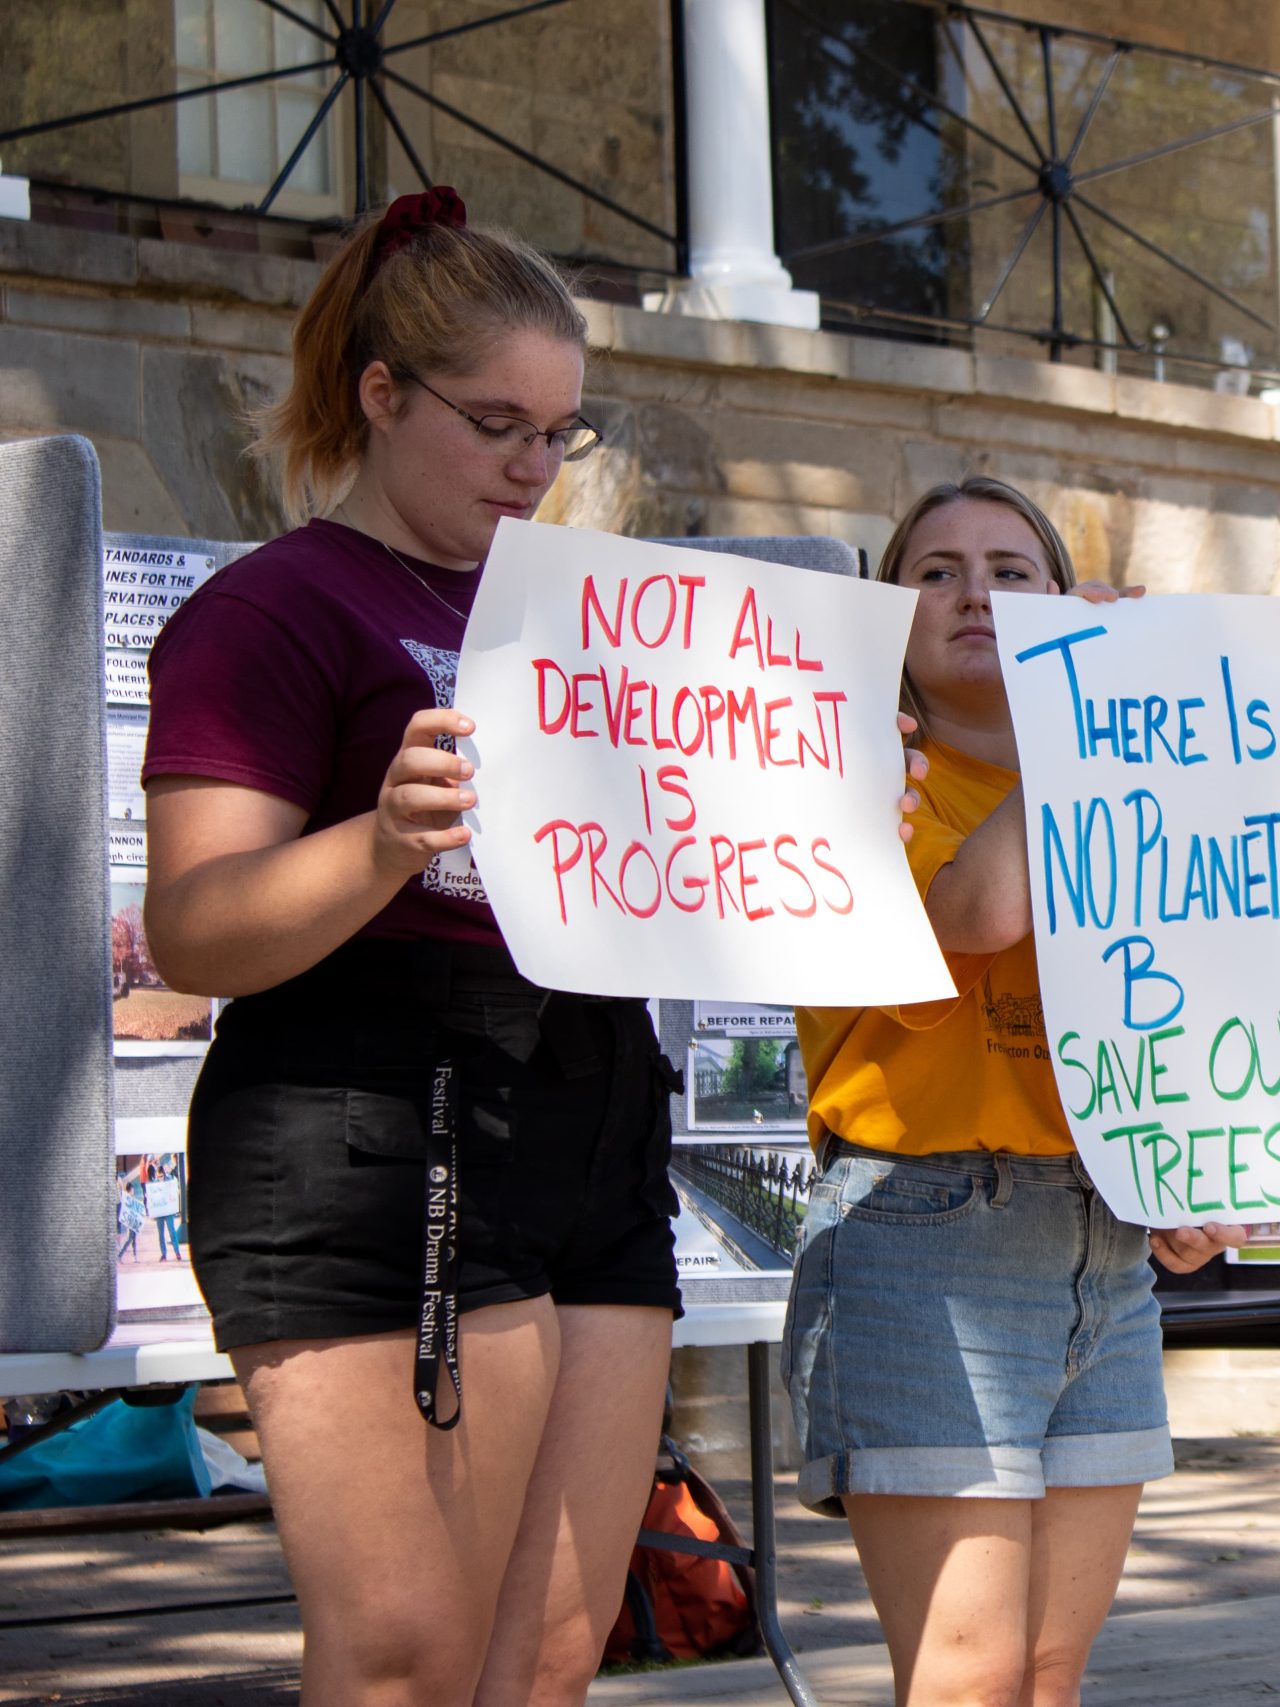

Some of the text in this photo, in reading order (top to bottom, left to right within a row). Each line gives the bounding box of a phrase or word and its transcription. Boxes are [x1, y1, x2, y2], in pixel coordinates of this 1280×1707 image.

[106, 571, 196, 588] INES FOR THE
[177, 555, 186, 567] &
[105, 612, 154, 627] PLACES
[581, 573, 824, 673] NOT ALL
[531, 658, 848, 779] DEVELOPMENT
[1014, 624, 1209, 767] THERE
[638, 764, 697, 835] IS
[533, 818, 854, 926] PROGRESS
[1041, 796, 1117, 936] NO
[707, 1016, 756, 1026] BEFORE
[1102, 935, 1185, 1031] B
[431, 1066, 454, 1136] Festival
[1057, 1025, 1190, 1121] SAVE
[418, 1187, 447, 1360] NB Drama Festival
